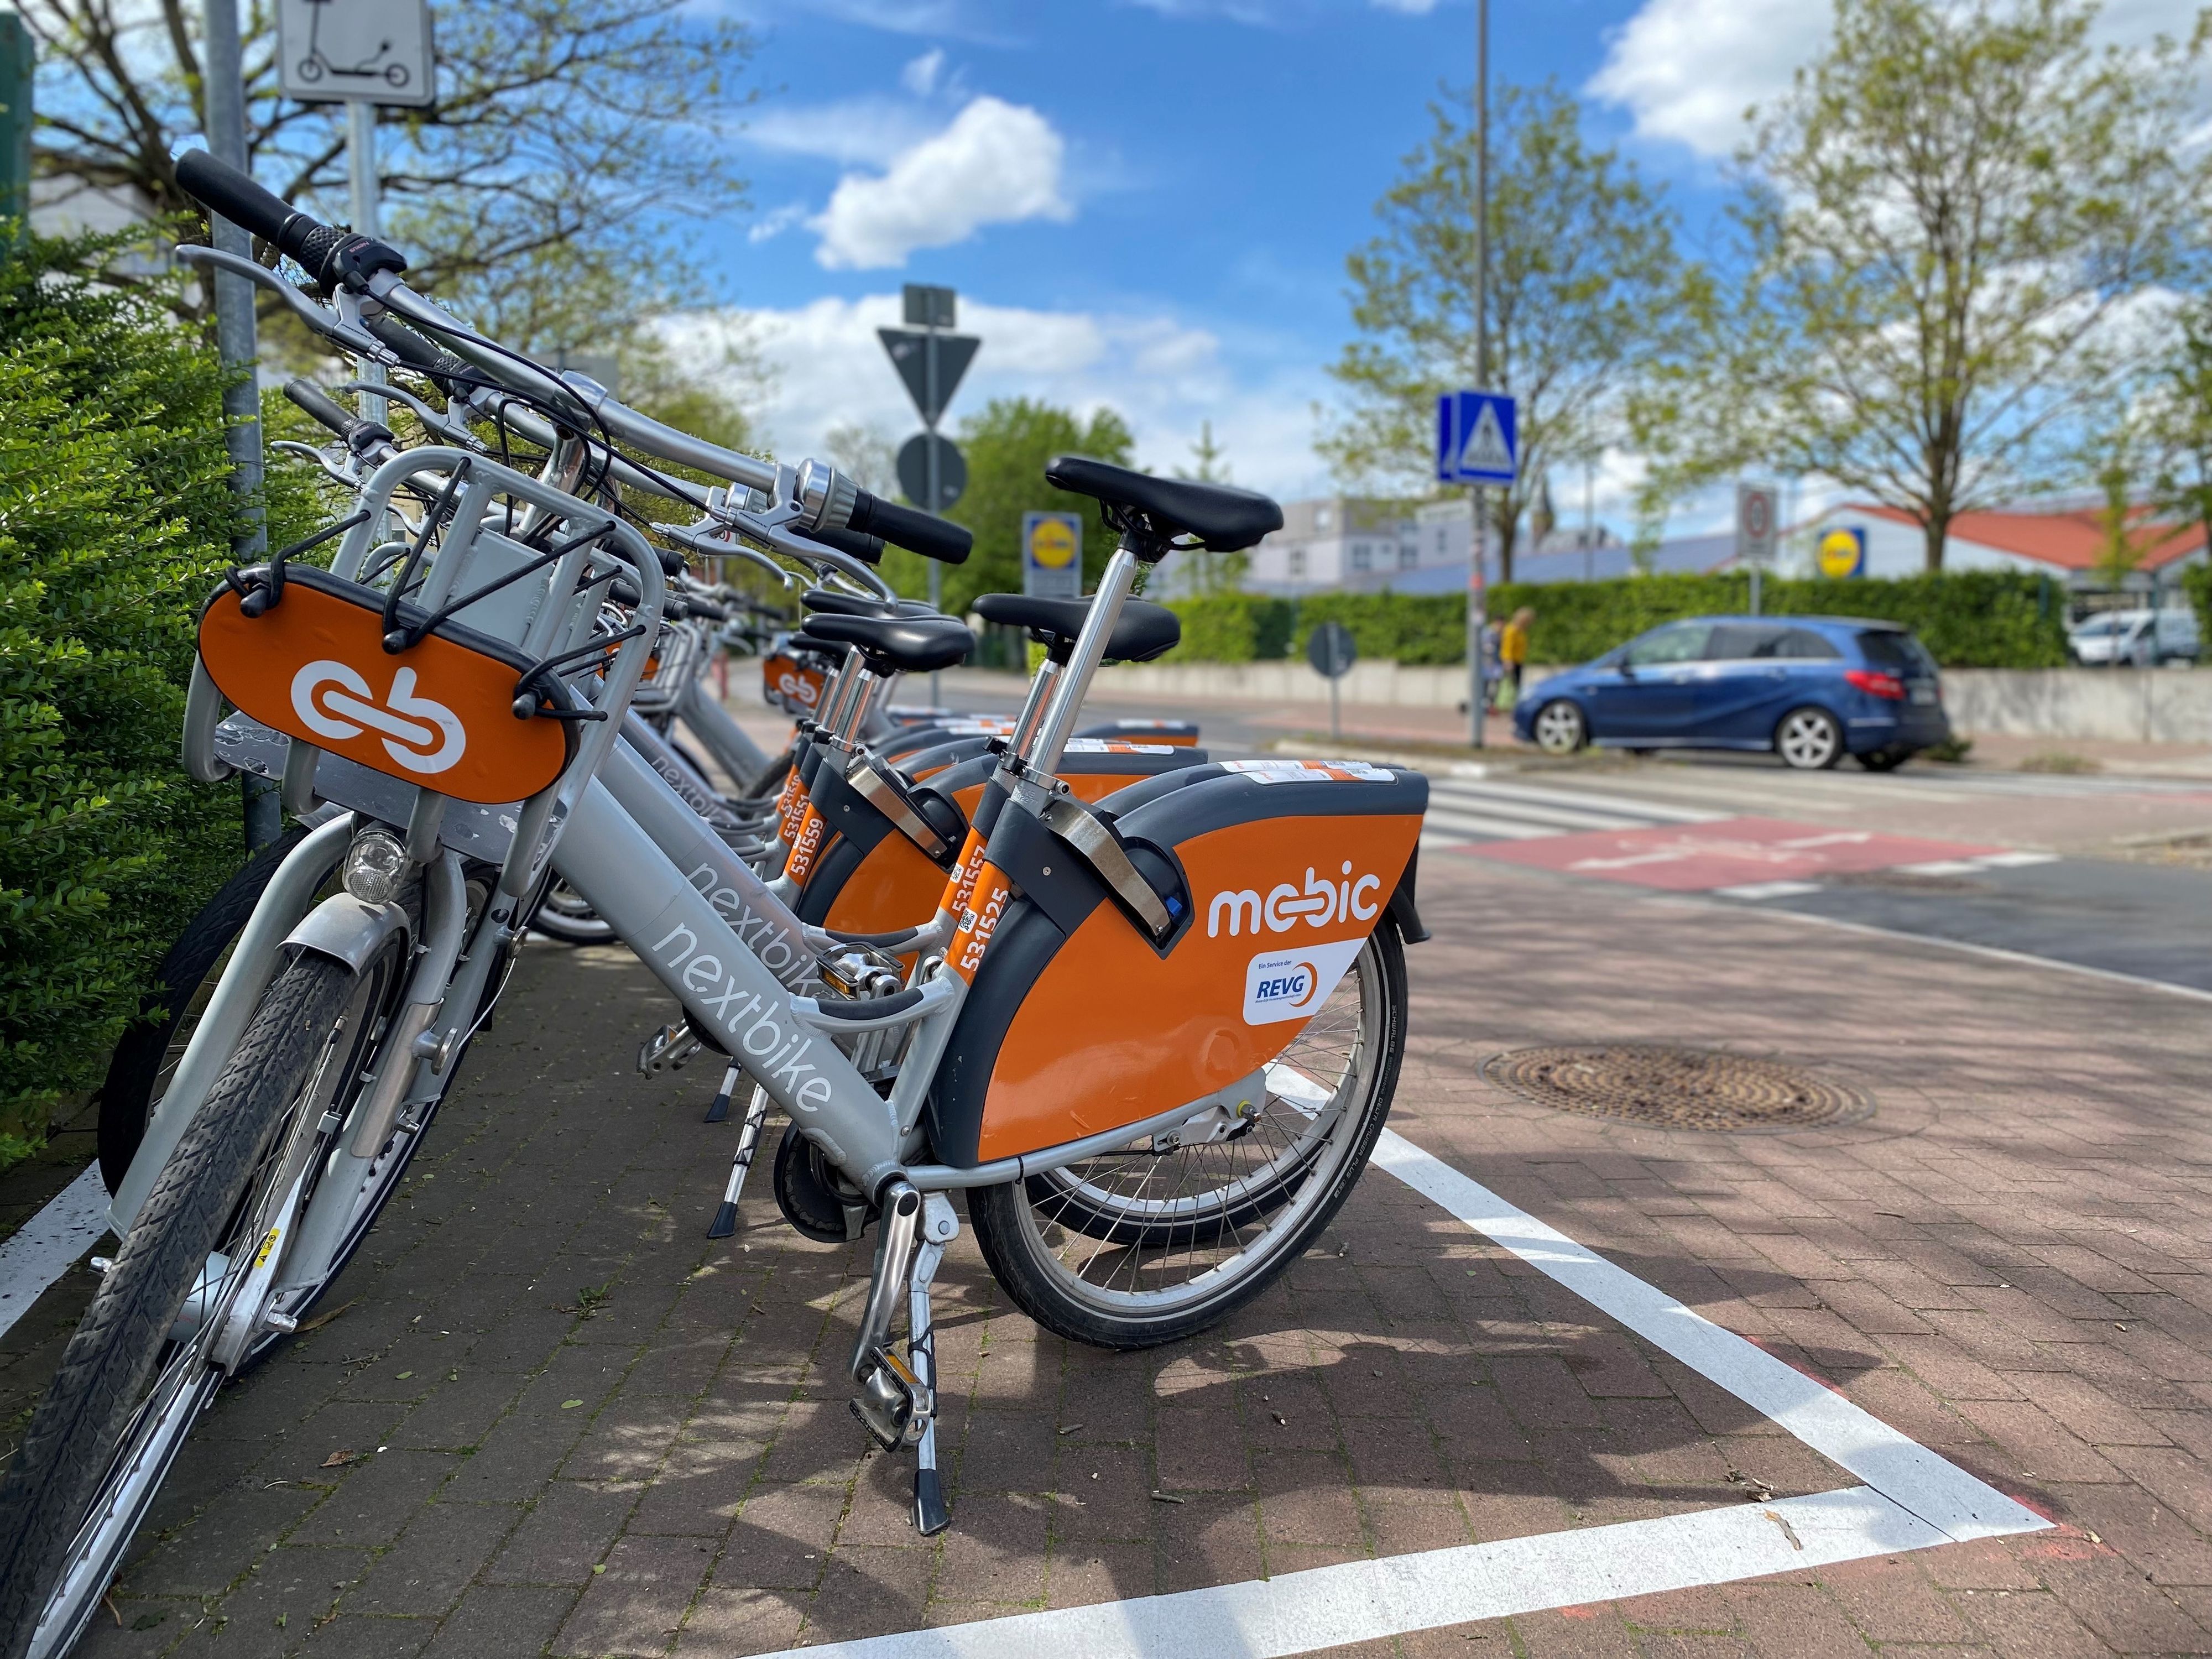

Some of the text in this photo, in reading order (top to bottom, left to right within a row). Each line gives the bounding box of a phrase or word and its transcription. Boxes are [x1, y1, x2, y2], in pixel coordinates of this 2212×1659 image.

[784, 794, 810, 839] 531551
[790, 818, 823, 876] 531559
[952, 845, 985, 912] 531557
[1207, 860, 1380, 938] mobic
[960, 887, 1009, 972] 531525
[1256, 975, 1305, 999] REVG
[651, 922, 832, 1112] nextbike
[1373, 1098, 1383, 1121] DELTA
[1358, 1123, 1375, 1157] CRUISER
[1346, 1158, 1359, 1179] PLUS
